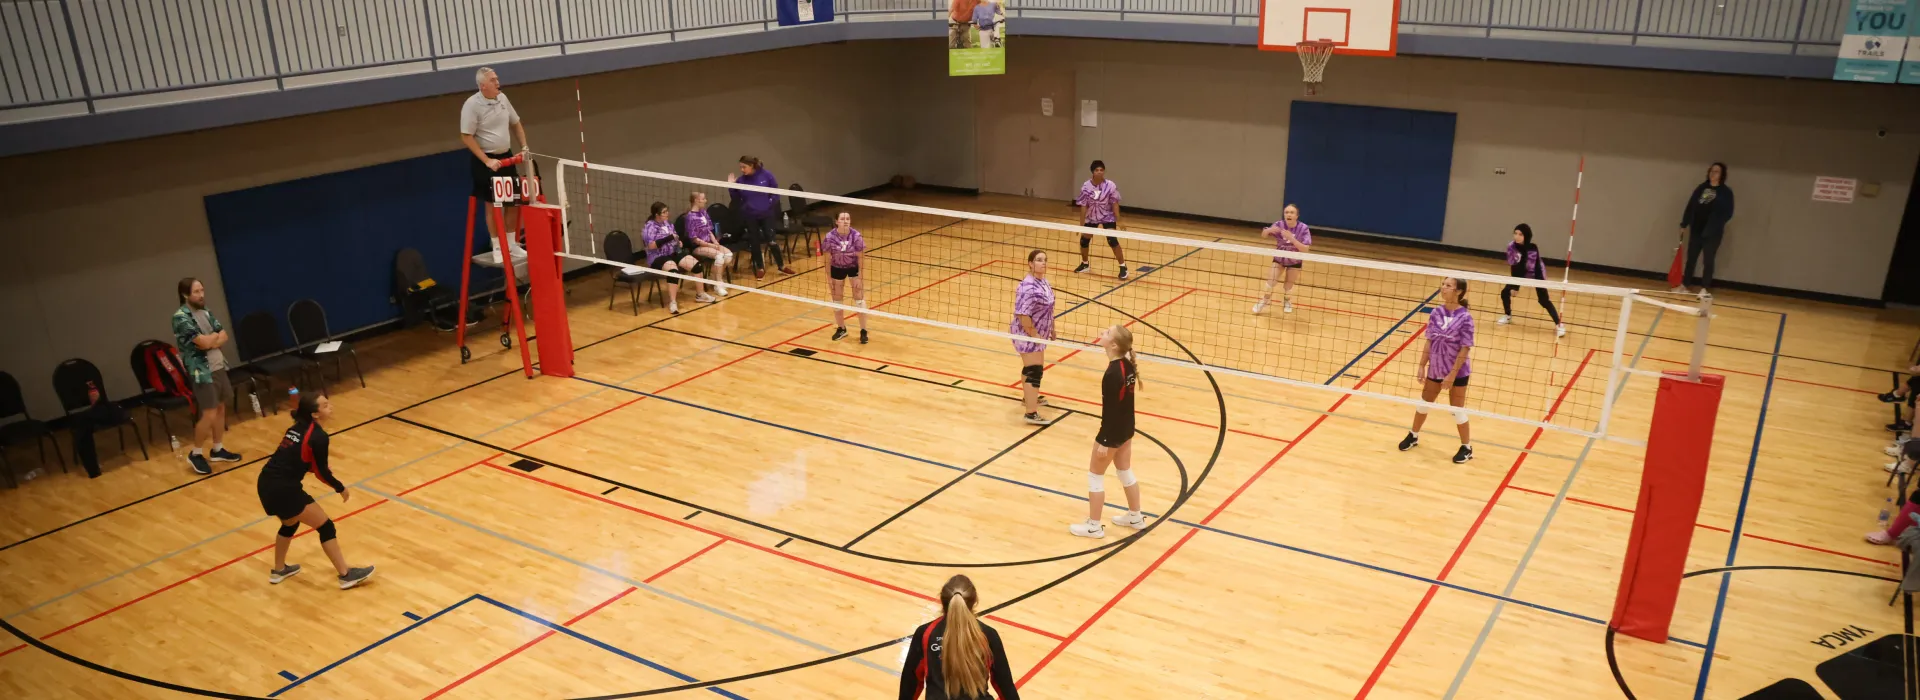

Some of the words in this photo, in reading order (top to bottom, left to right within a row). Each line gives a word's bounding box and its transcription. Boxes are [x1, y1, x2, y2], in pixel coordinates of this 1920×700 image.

[1856, 11, 1907, 31] YOU
[496, 180, 513, 198] 00
[1810, 624, 1875, 650] YMCA
